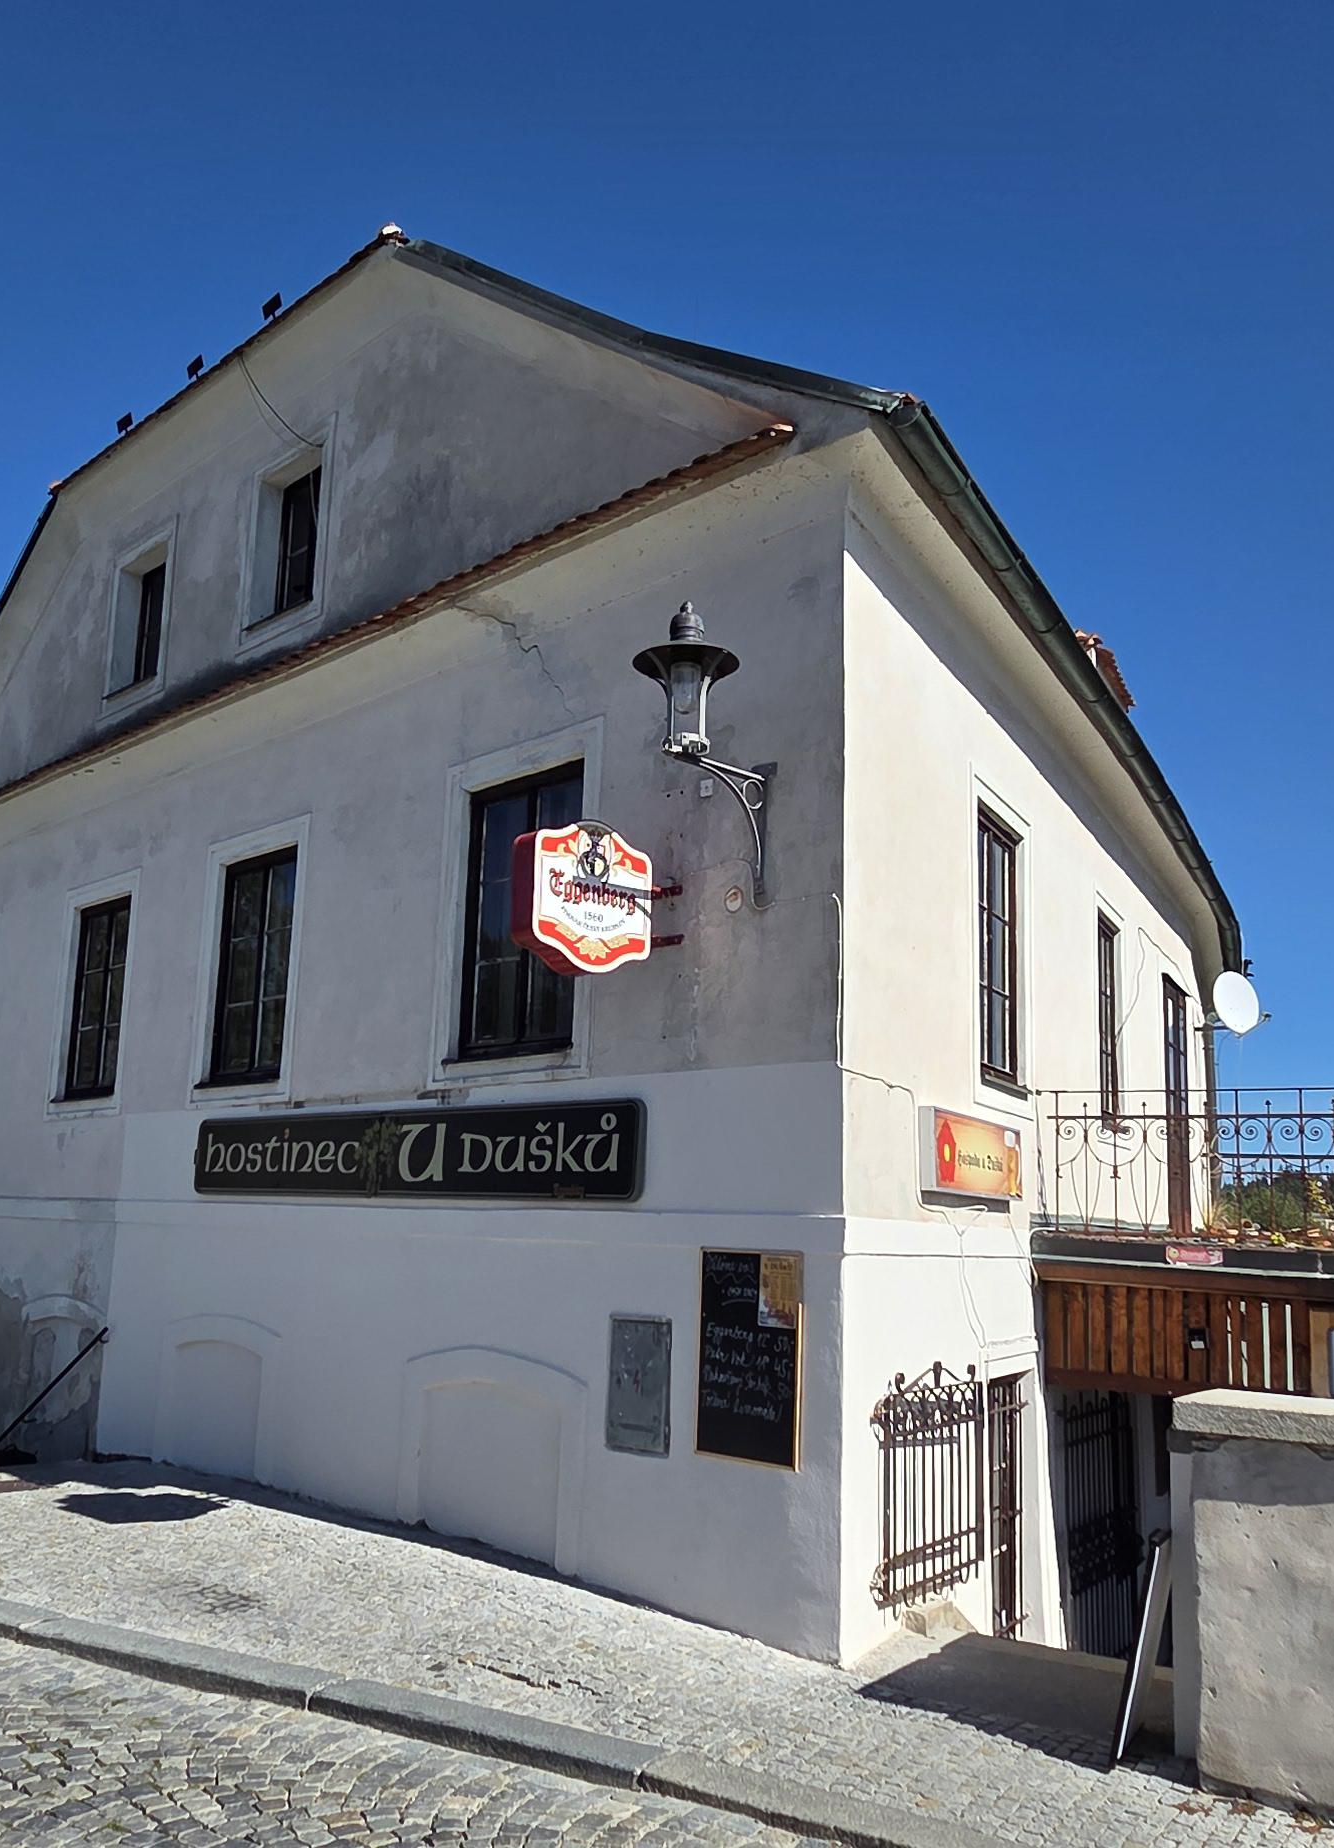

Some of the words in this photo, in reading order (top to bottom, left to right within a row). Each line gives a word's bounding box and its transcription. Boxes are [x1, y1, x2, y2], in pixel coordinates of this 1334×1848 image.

[549, 867, 636, 916] Eggenberg
[583, 910, 604, 924] 1560
[204, 1127, 360, 1175] hostinec
[397, 1122, 448, 1183] U
